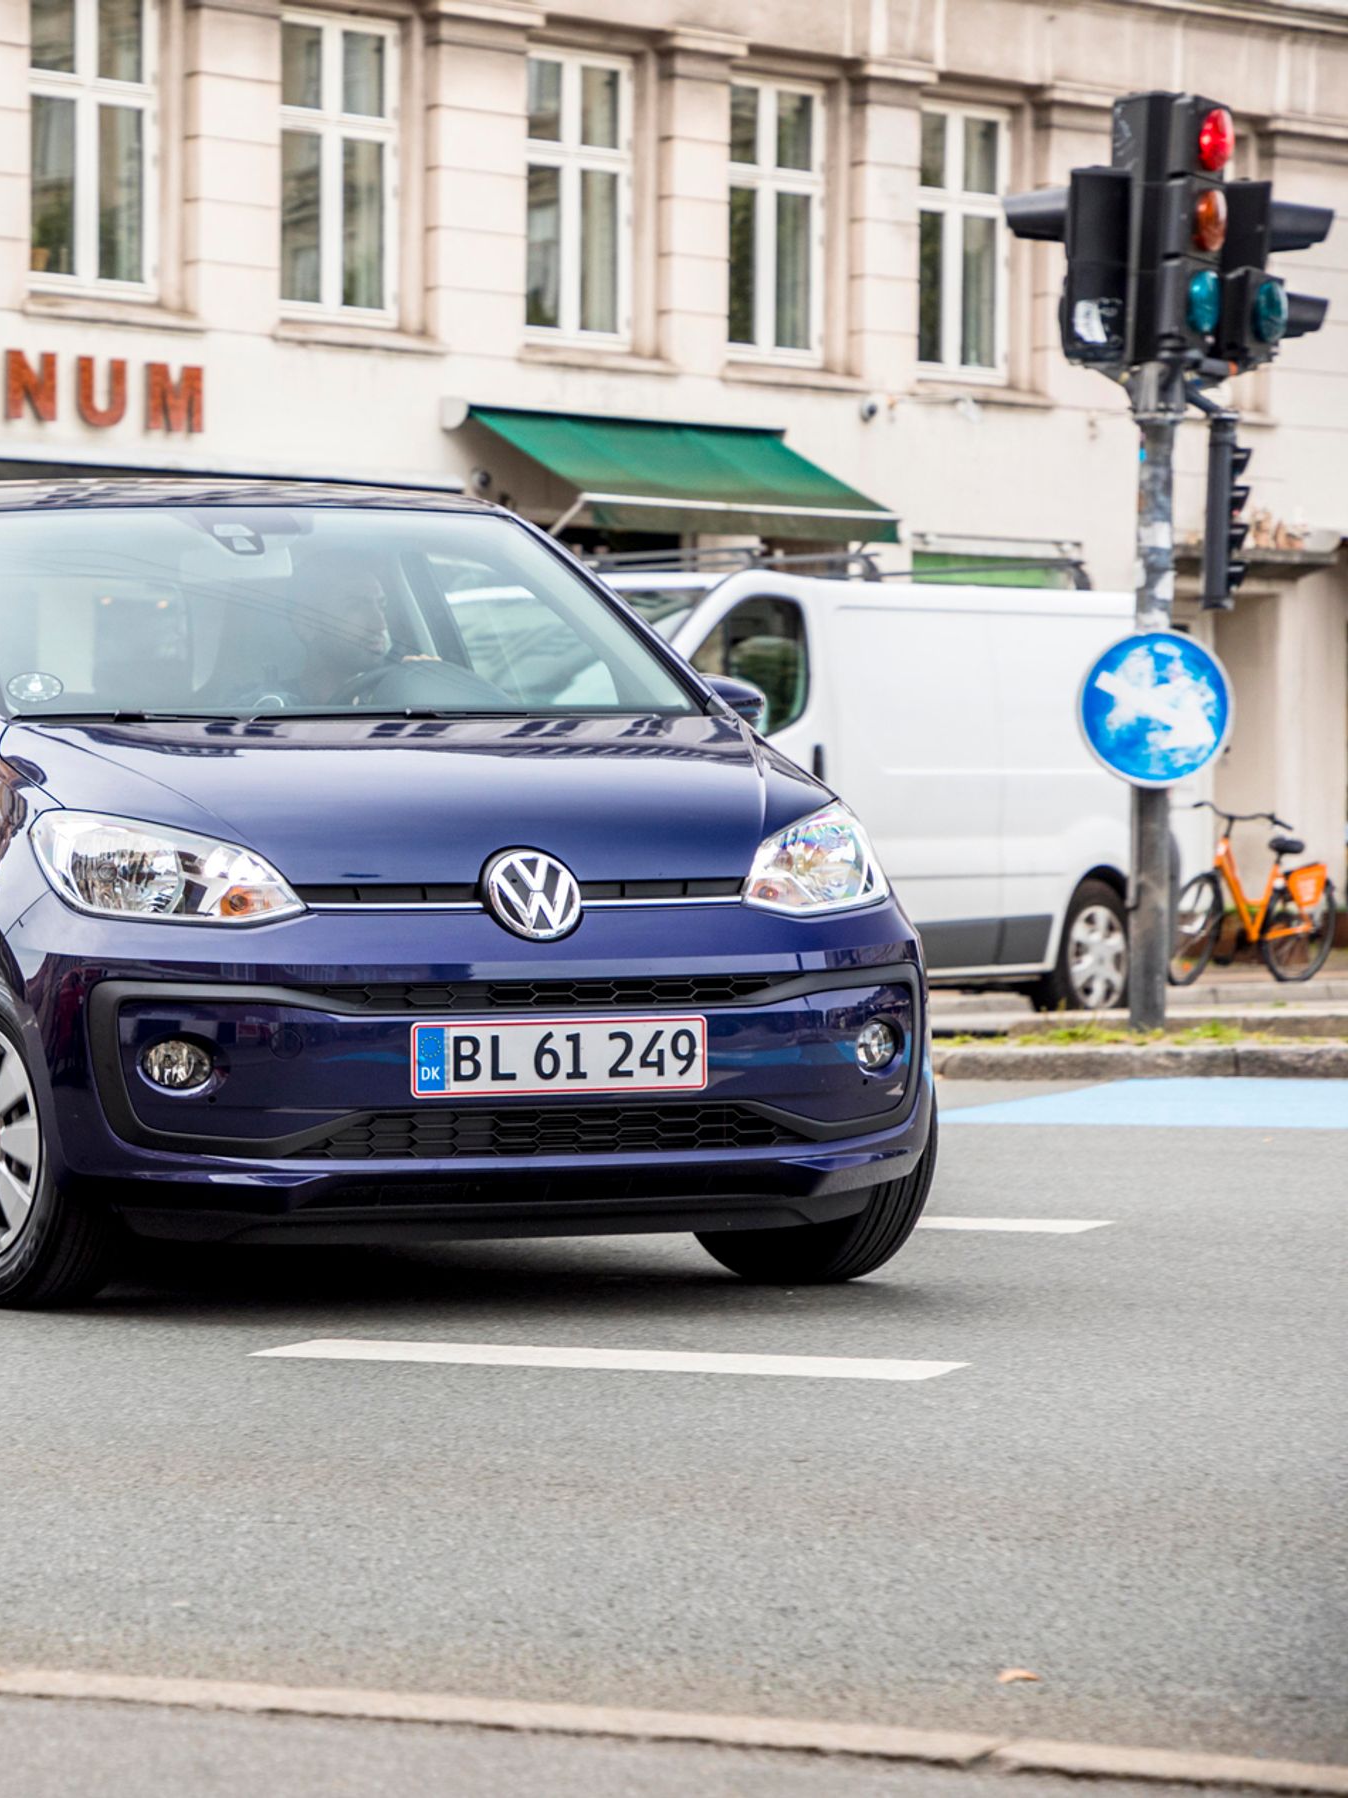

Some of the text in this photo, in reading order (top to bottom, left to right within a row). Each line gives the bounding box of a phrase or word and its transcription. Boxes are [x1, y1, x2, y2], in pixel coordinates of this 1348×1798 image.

[452, 1028, 698, 1082] BL 61 249
[420, 1065, 441, 1082] DK
